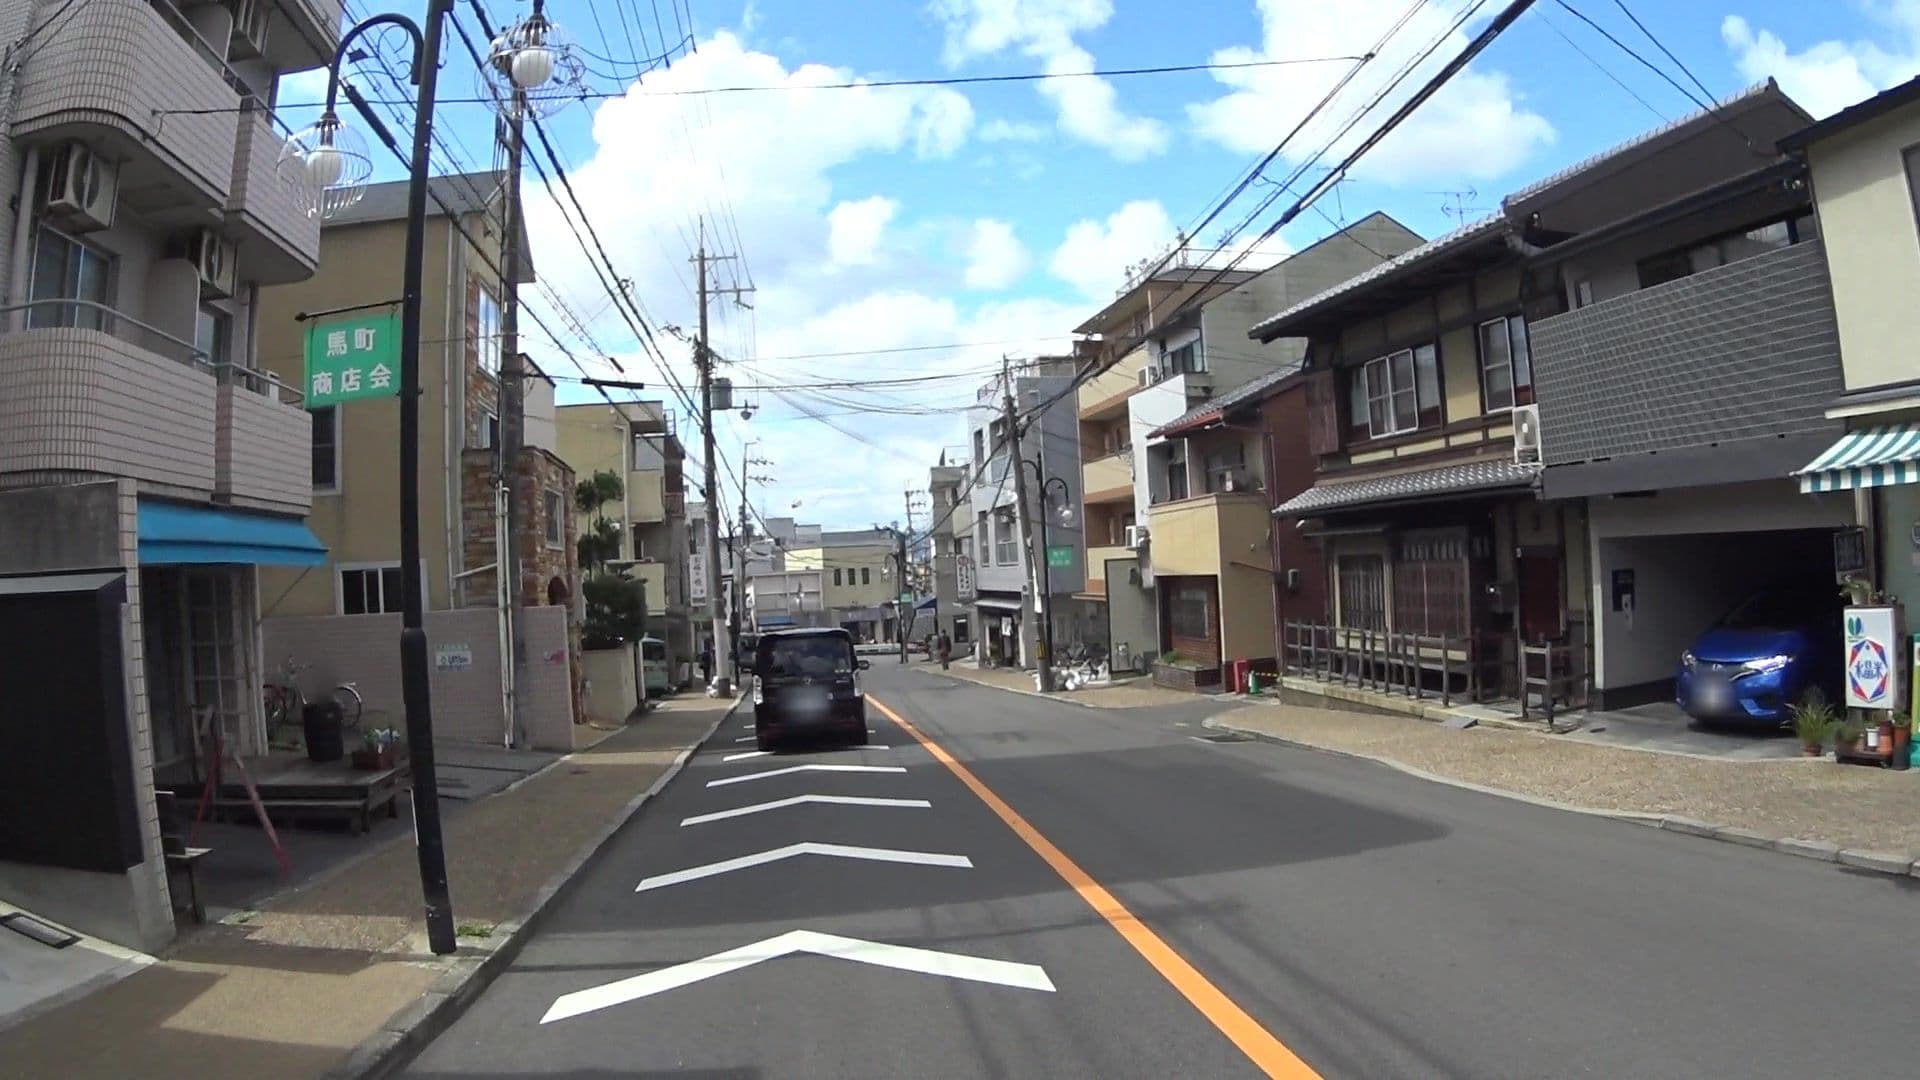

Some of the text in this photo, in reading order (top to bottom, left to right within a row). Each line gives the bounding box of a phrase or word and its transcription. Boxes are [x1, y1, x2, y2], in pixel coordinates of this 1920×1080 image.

[326, 327, 376, 357] 馬町
[312, 362, 392, 397] 商店会
